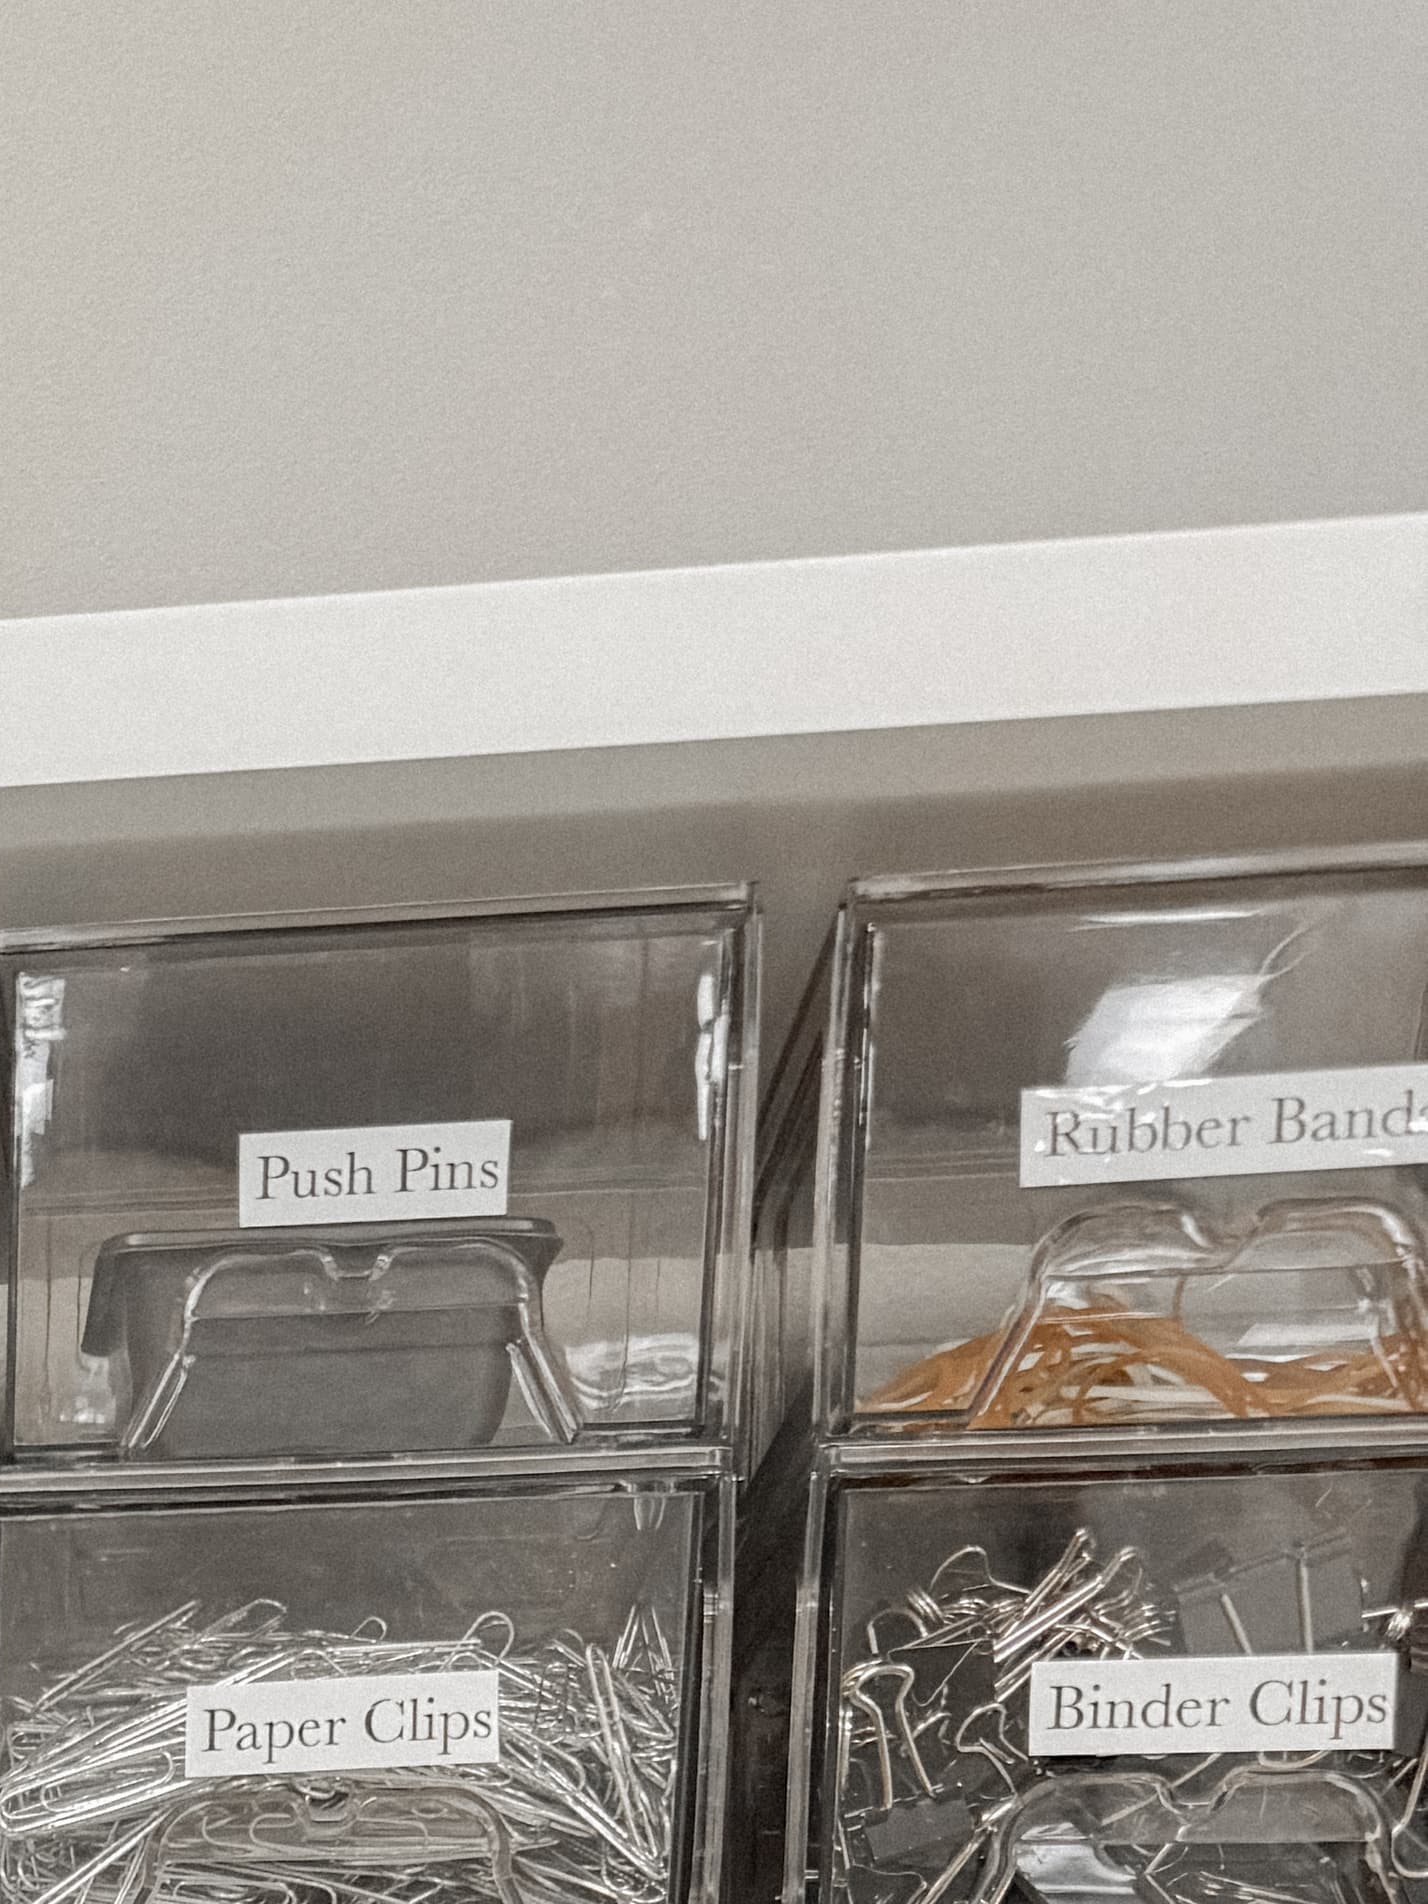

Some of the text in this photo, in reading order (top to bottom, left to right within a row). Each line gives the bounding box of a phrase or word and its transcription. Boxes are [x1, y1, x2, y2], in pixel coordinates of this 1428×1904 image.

[1043, 1107, 1252, 1158] Rubber
[255, 1146, 499, 1200] Push Pins
[201, 1696, 493, 1765] Paper Clips
[1046, 1678, 1388, 1741] Binder Clips
